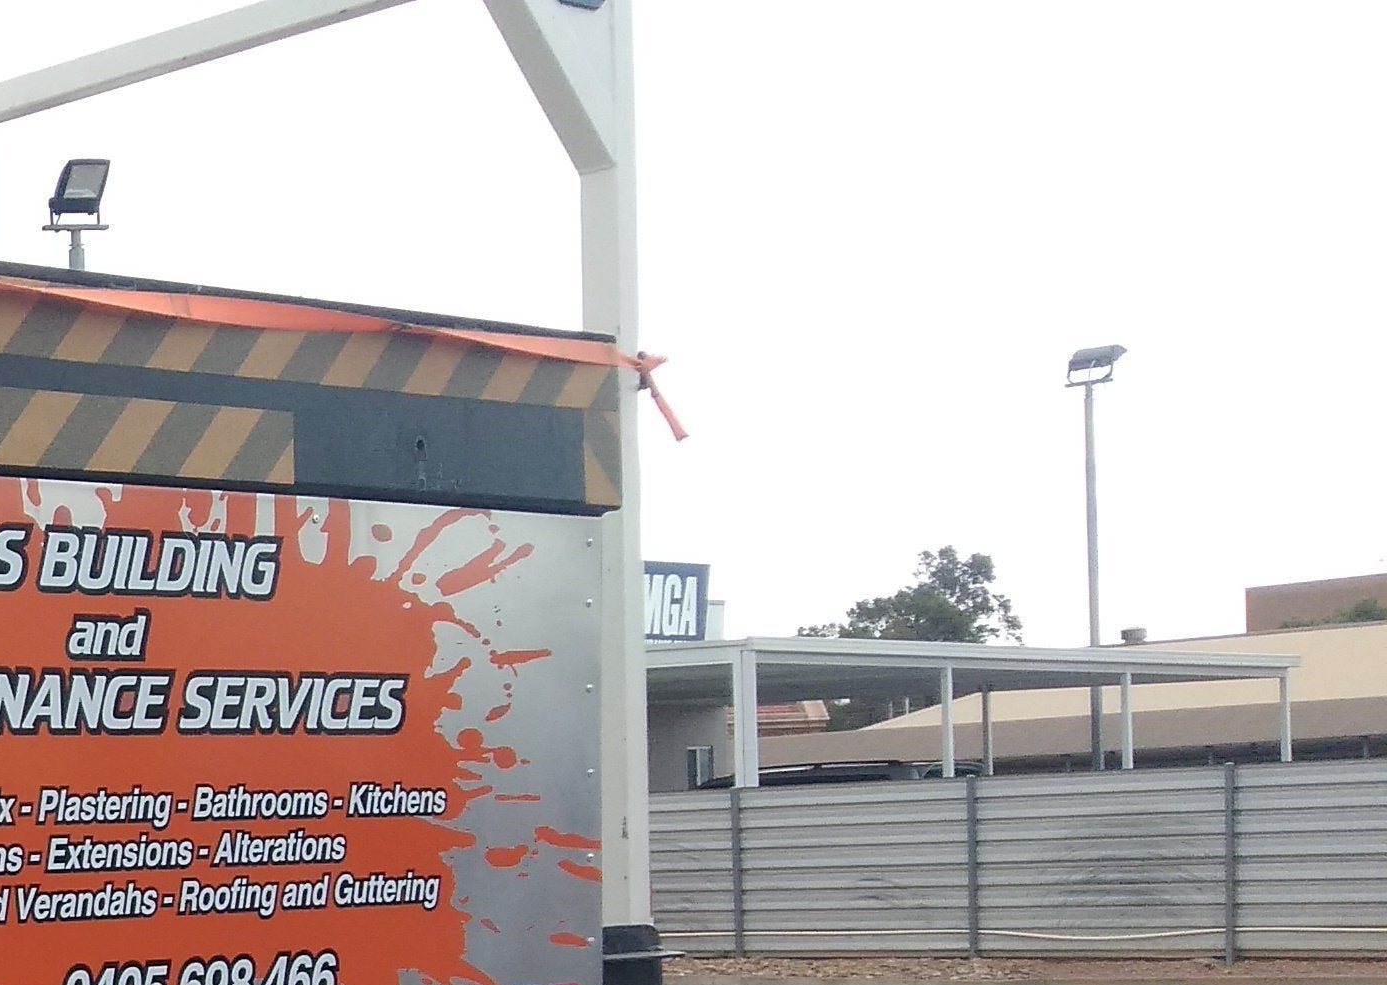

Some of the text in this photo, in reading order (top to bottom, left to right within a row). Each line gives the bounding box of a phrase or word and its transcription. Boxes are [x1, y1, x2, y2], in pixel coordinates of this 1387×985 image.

[39, 531, 278, 595] BUILDING
[68, 615, 147, 656] and
[179, 676, 405, 730] SERVICES
[38, 787, 172, 827] Plastering
[193, 786, 328, 818] Bathrooms
[348, 784, 446, 819] Kitchens
[47, 834, 193, 870] Extensions
[213, 830, 346, 864] Alterations
[17, 882, 158, 920] Verandahs
[179, 878, 278, 916] Roofing
[282, 875, 330, 907] and
[334, 871, 440, 909] Guttering
